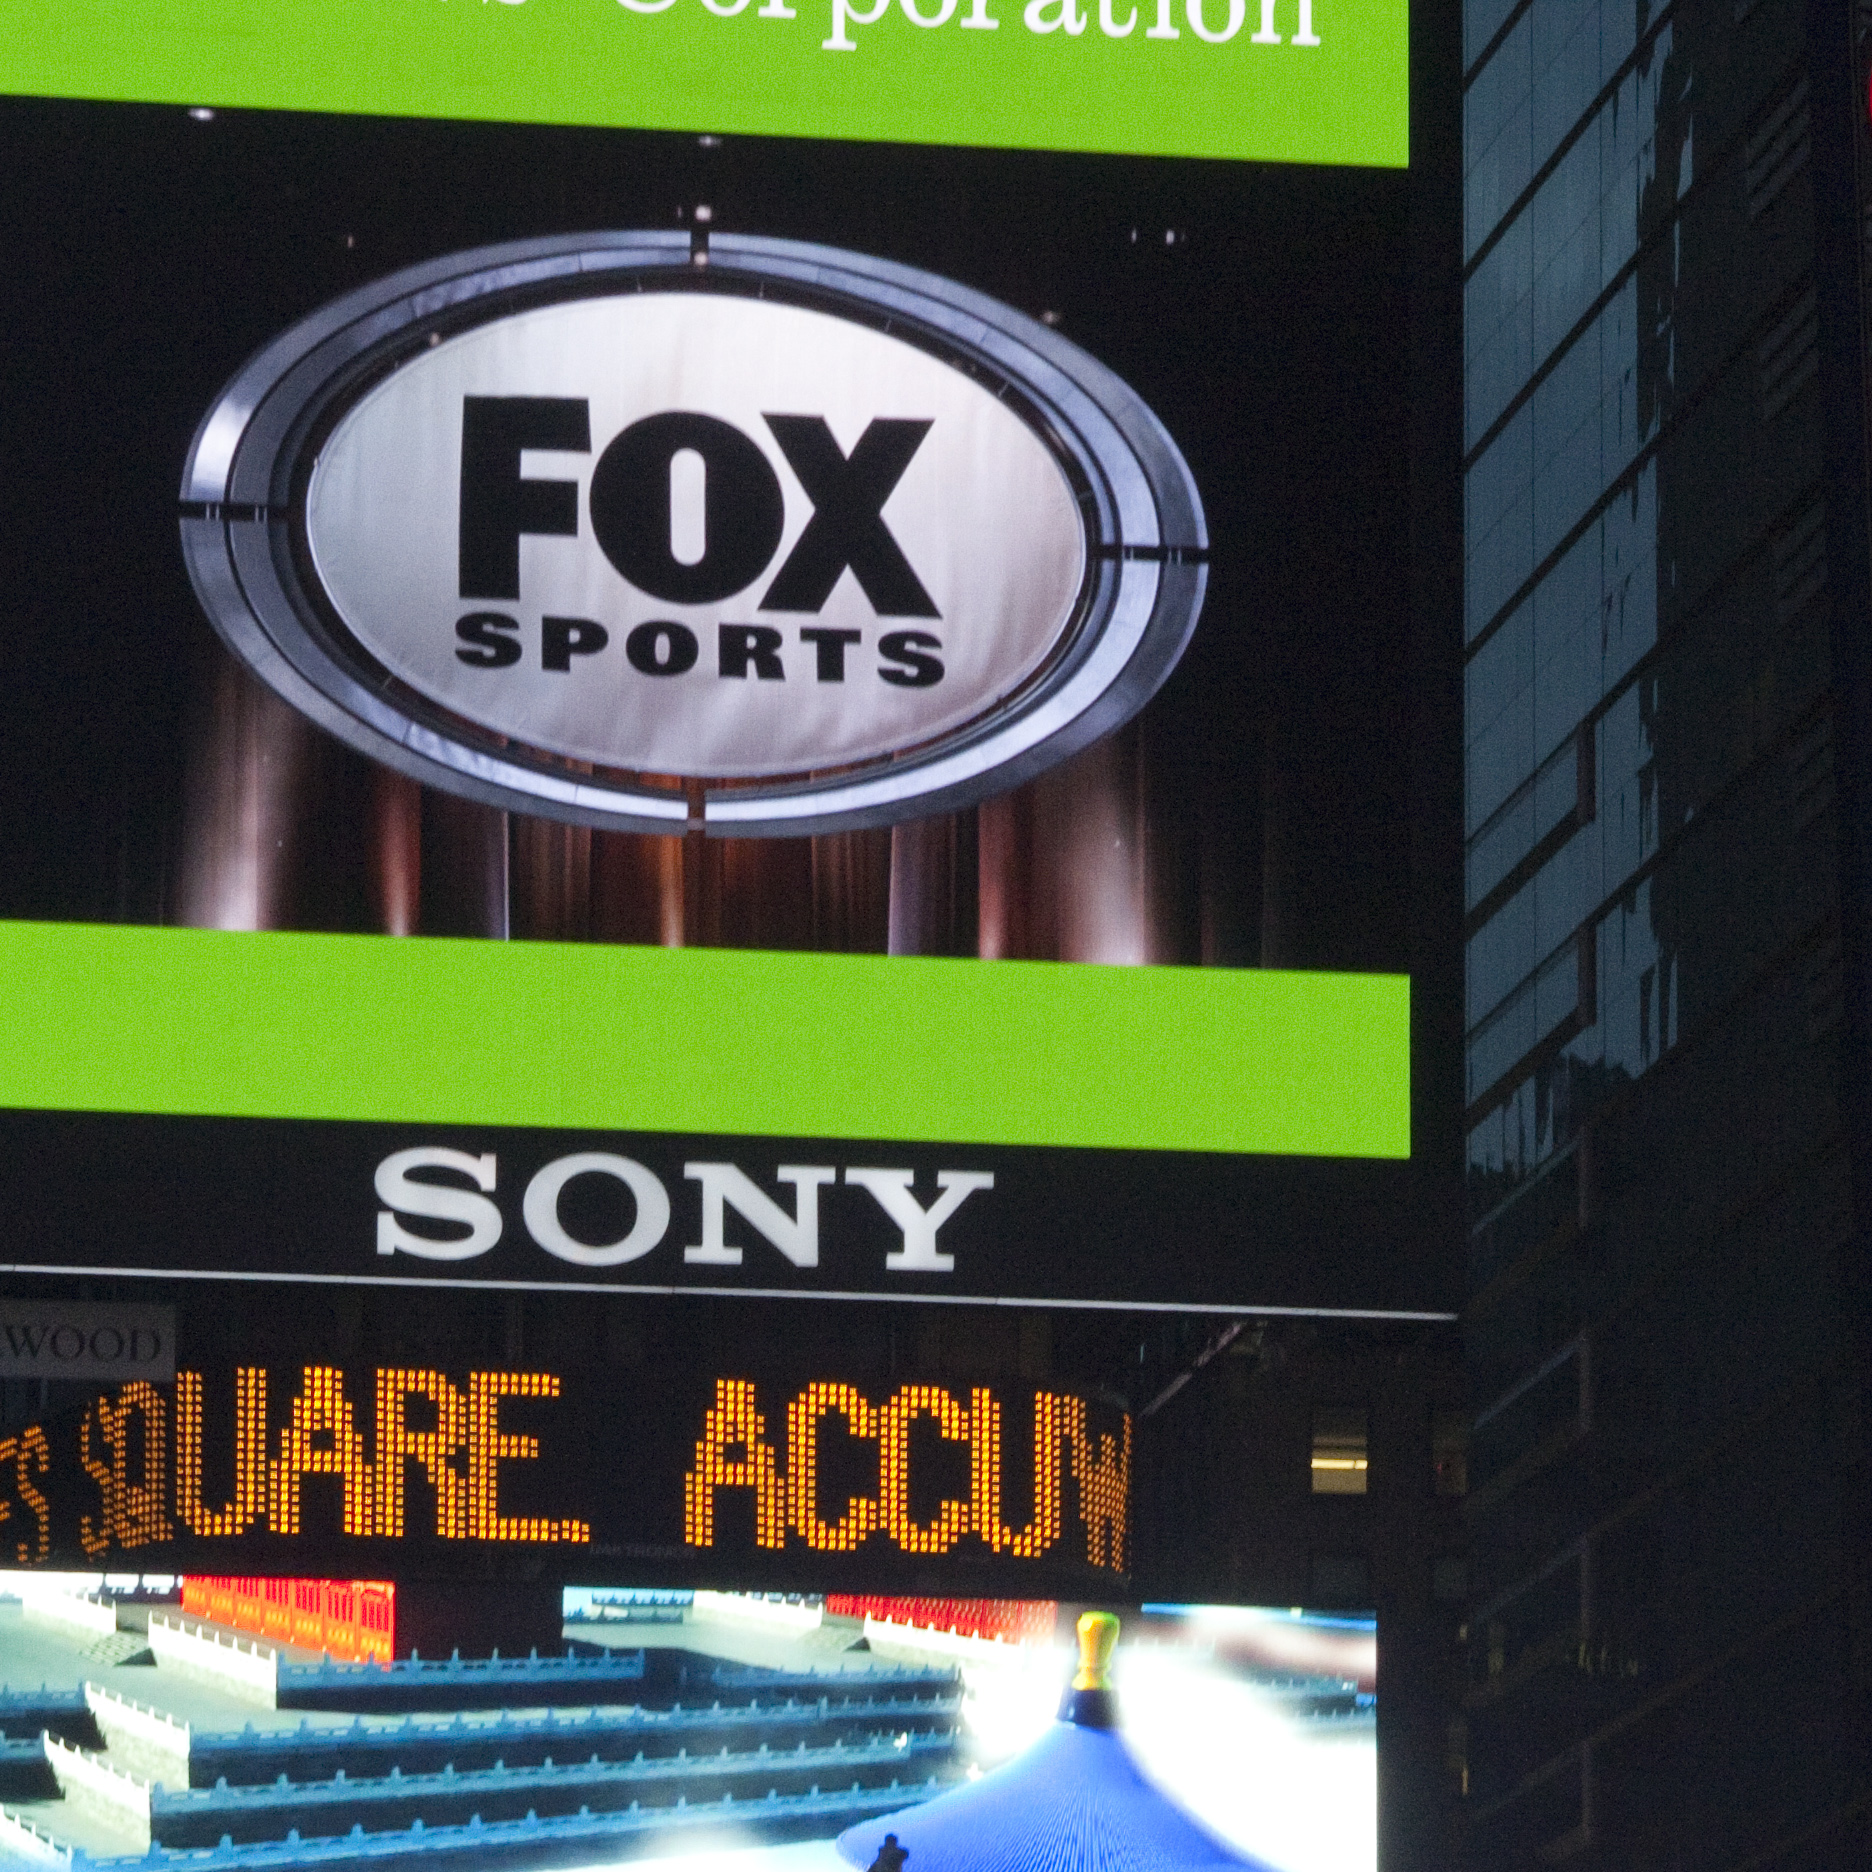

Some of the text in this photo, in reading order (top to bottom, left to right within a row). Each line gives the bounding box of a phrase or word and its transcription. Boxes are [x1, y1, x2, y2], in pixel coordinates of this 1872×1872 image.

[459, 394, 944, 620] FOX
[454, 611, 946, 688] SPORTS
[374, 1146, 994, 1272] SONY
